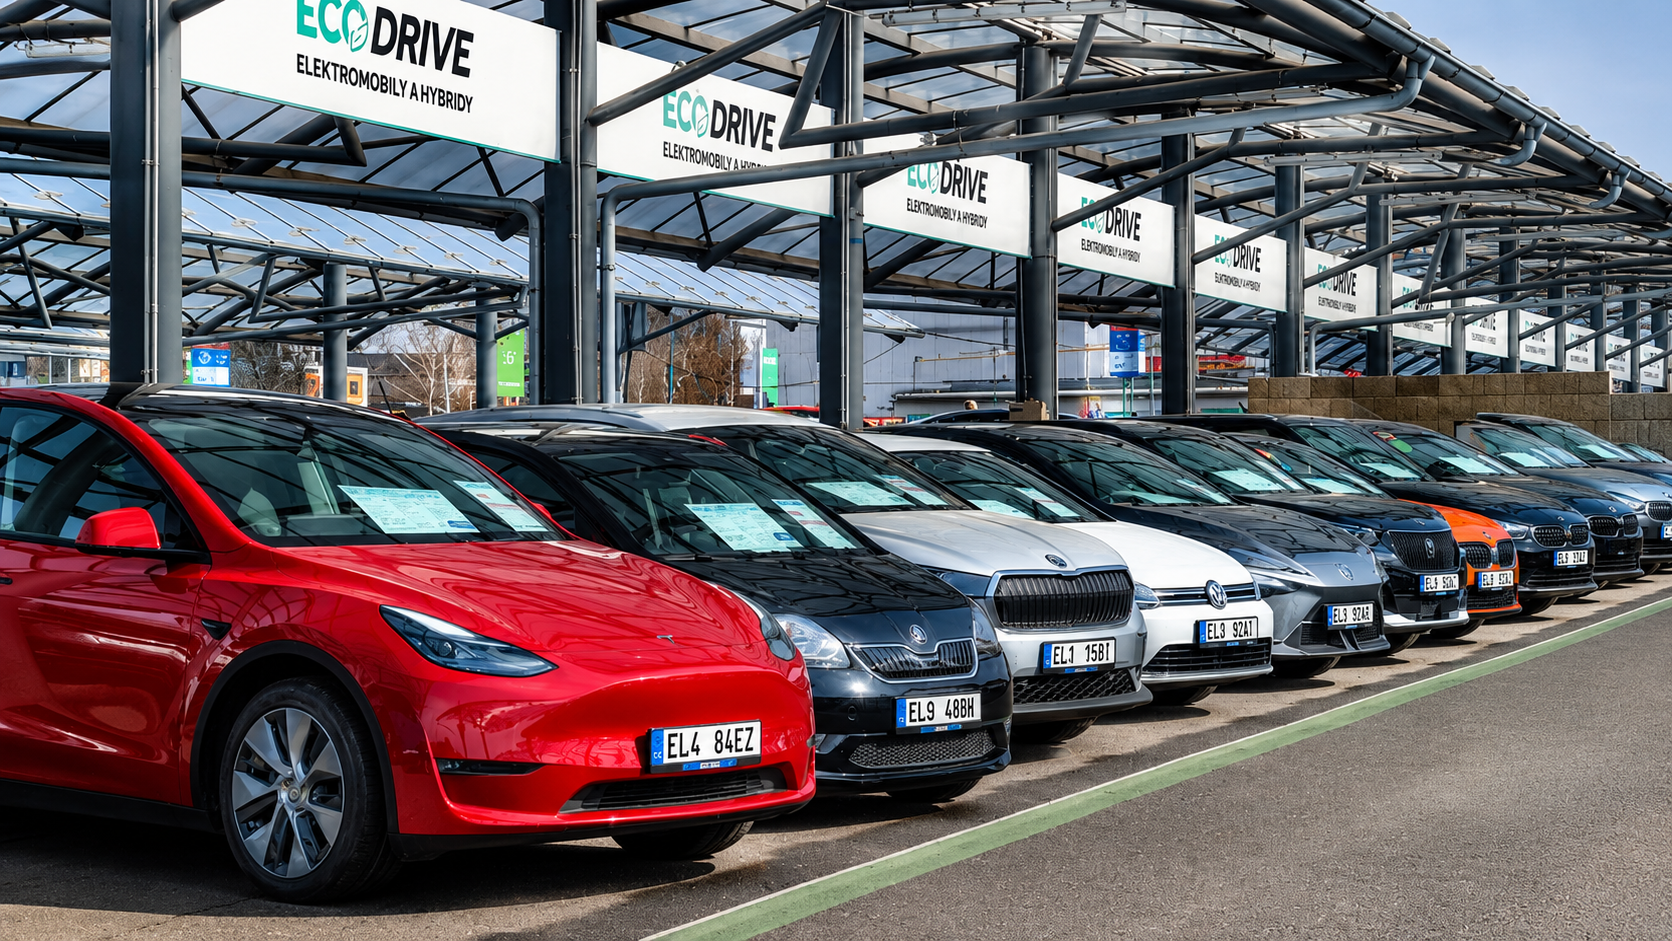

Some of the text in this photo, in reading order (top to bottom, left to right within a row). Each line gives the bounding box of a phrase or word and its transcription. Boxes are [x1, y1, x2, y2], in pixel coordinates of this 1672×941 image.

[297, 53, 473, 113] ELEKTROMOBILY A HYBRIDY
[663, 141, 732, 171] ELEKTROMOBILY
[909, 697, 974, 723] EL9 48BH
[668, 726, 754, 759] EL4 84EZ
